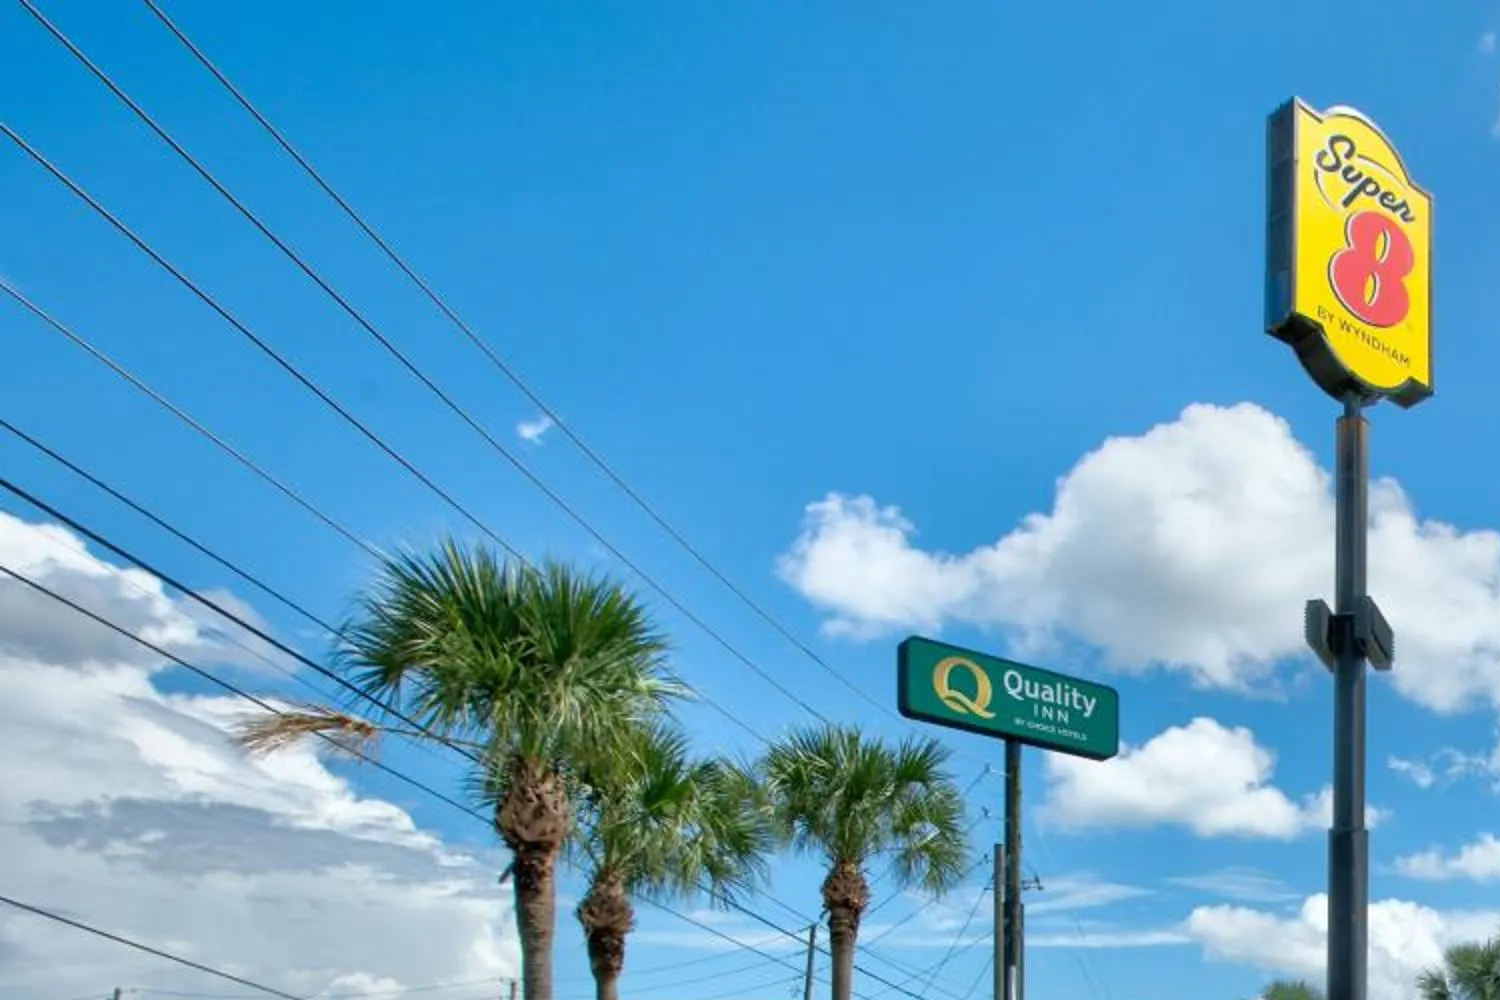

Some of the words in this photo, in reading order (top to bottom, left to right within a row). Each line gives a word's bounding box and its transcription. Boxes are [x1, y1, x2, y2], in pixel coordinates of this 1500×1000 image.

[1315, 133, 1416, 223] Super
[1327, 210, 1415, 328] 8
[1317, 305, 1335, 323] BY
[1340, 317, 1411, 368] WYNDHAM
[1003, 669, 1096, 718] Quality
[1033, 703, 1070, 725] INN
